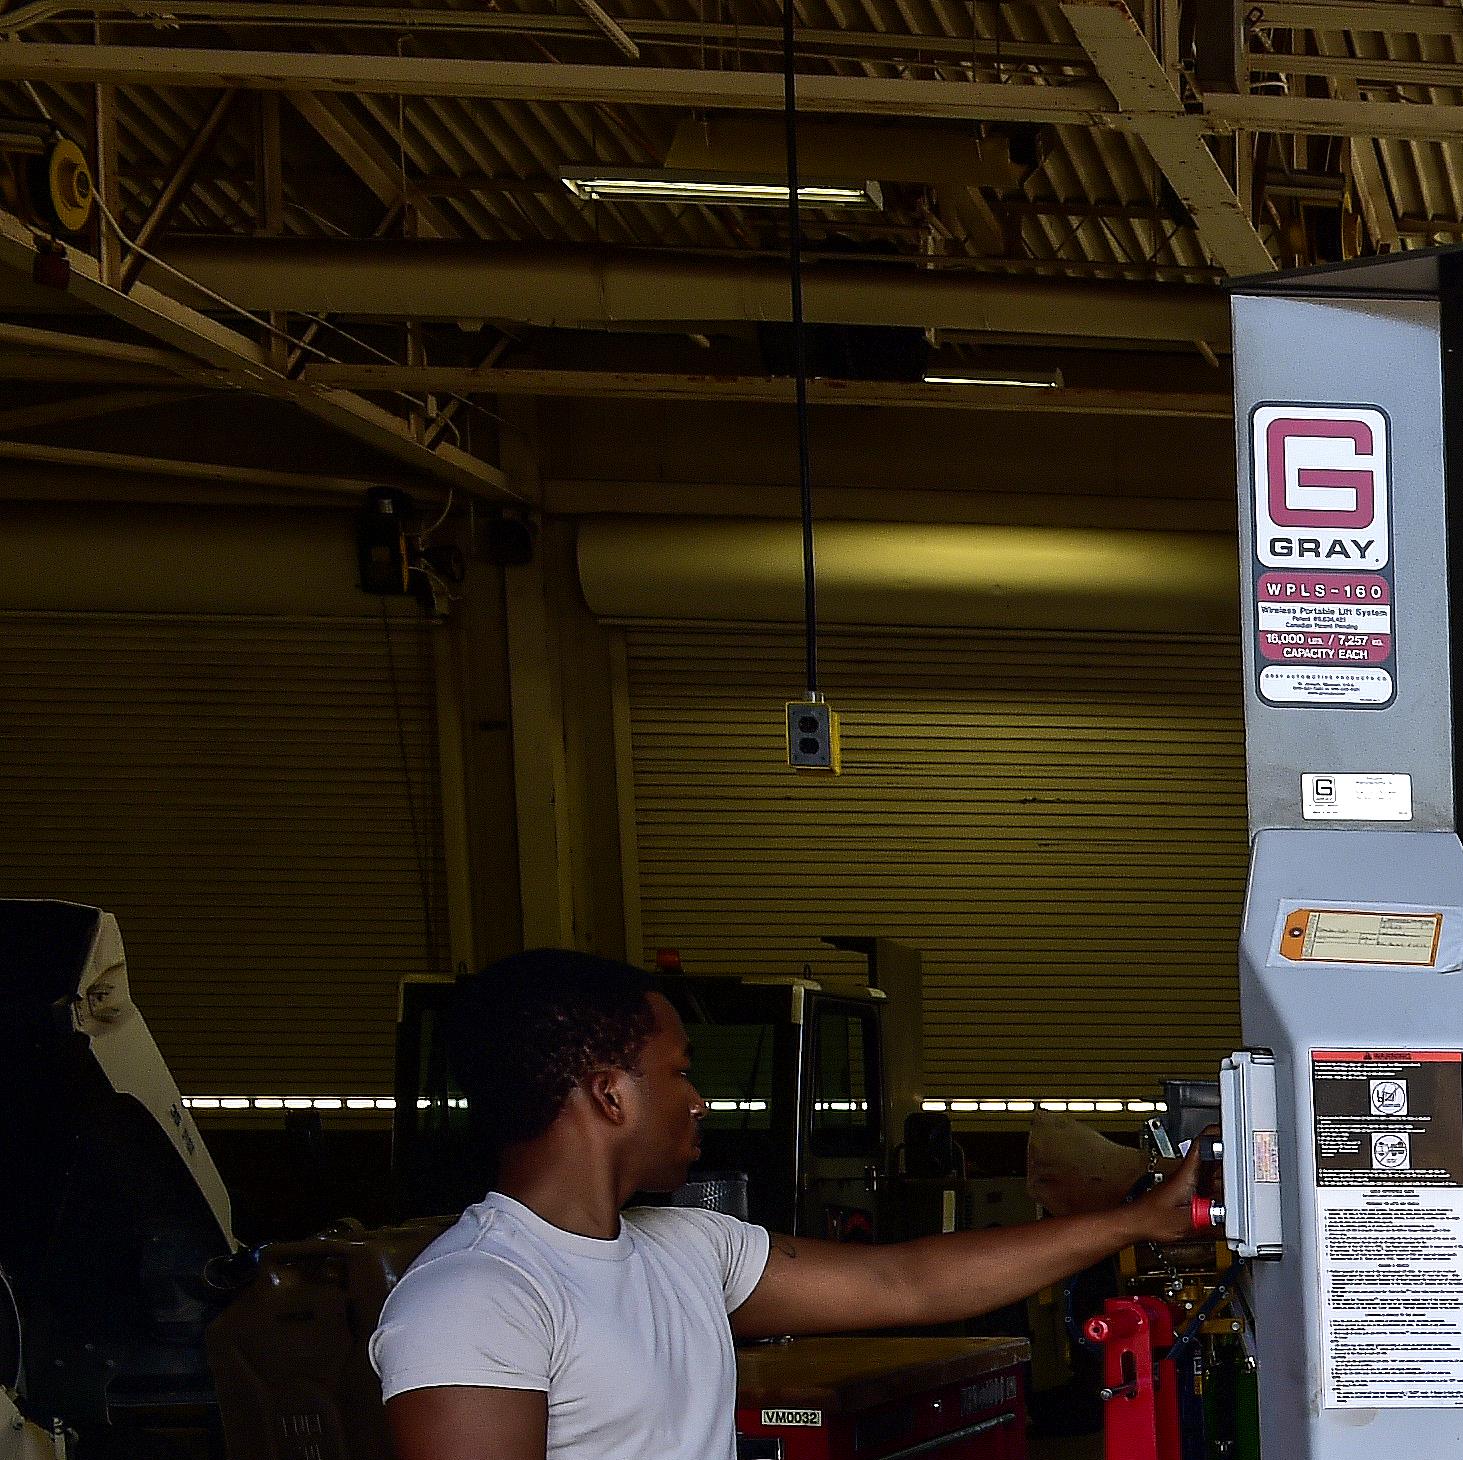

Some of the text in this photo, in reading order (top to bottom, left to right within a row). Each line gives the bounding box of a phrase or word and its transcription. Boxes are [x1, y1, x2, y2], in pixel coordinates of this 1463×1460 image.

[1267, 418, 1374, 529] G
[1269, 538, 1375, 559] GRAY
[1266, 583, 1382, 599] WPLS-160
[1356, 609, 1388, 618] System
[1266, 633, 1305, 645] 16,000
[1328, 634, 1335, 645] /
[1338, 635, 1368, 646] 7,257
[1283, 648, 1368, 660] CAPACITY EACH
[766, 1411, 817, 1424] VM0032
